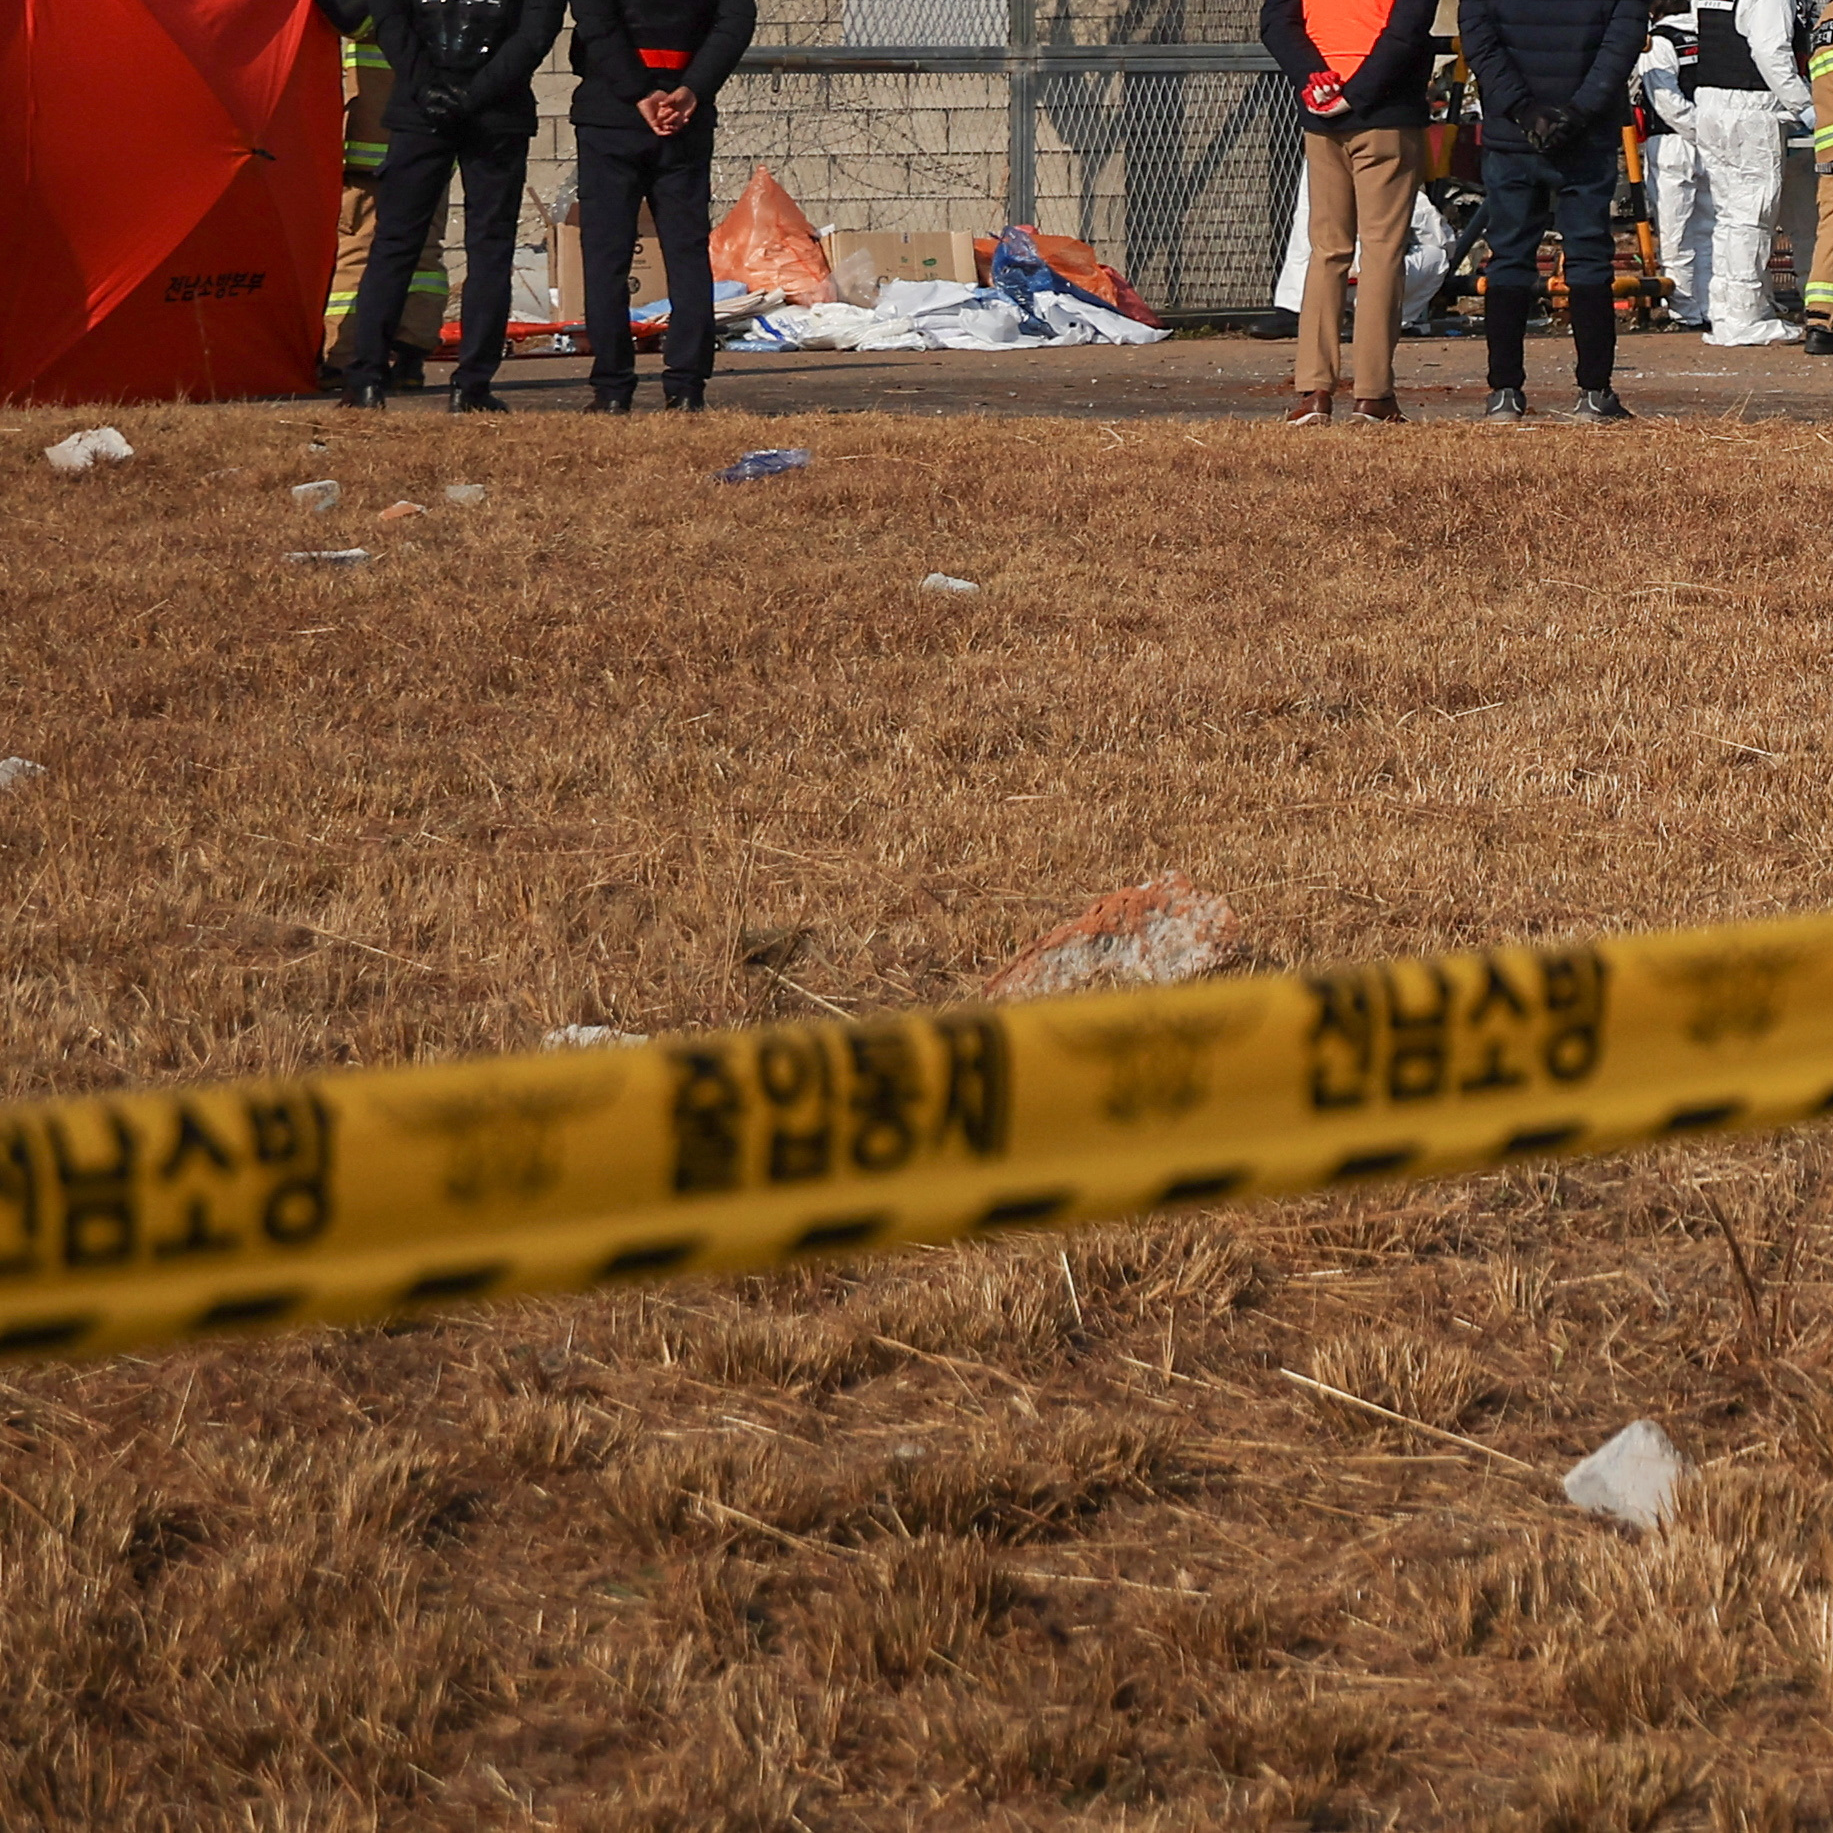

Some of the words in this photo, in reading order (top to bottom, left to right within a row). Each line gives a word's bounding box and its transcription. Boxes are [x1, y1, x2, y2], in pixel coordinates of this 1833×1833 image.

[164, 271, 266, 302] 전남소방본부
[669, 1013, 1013, 1194] 출입통제
[1306, 947, 1608, 1108] 전남소방
